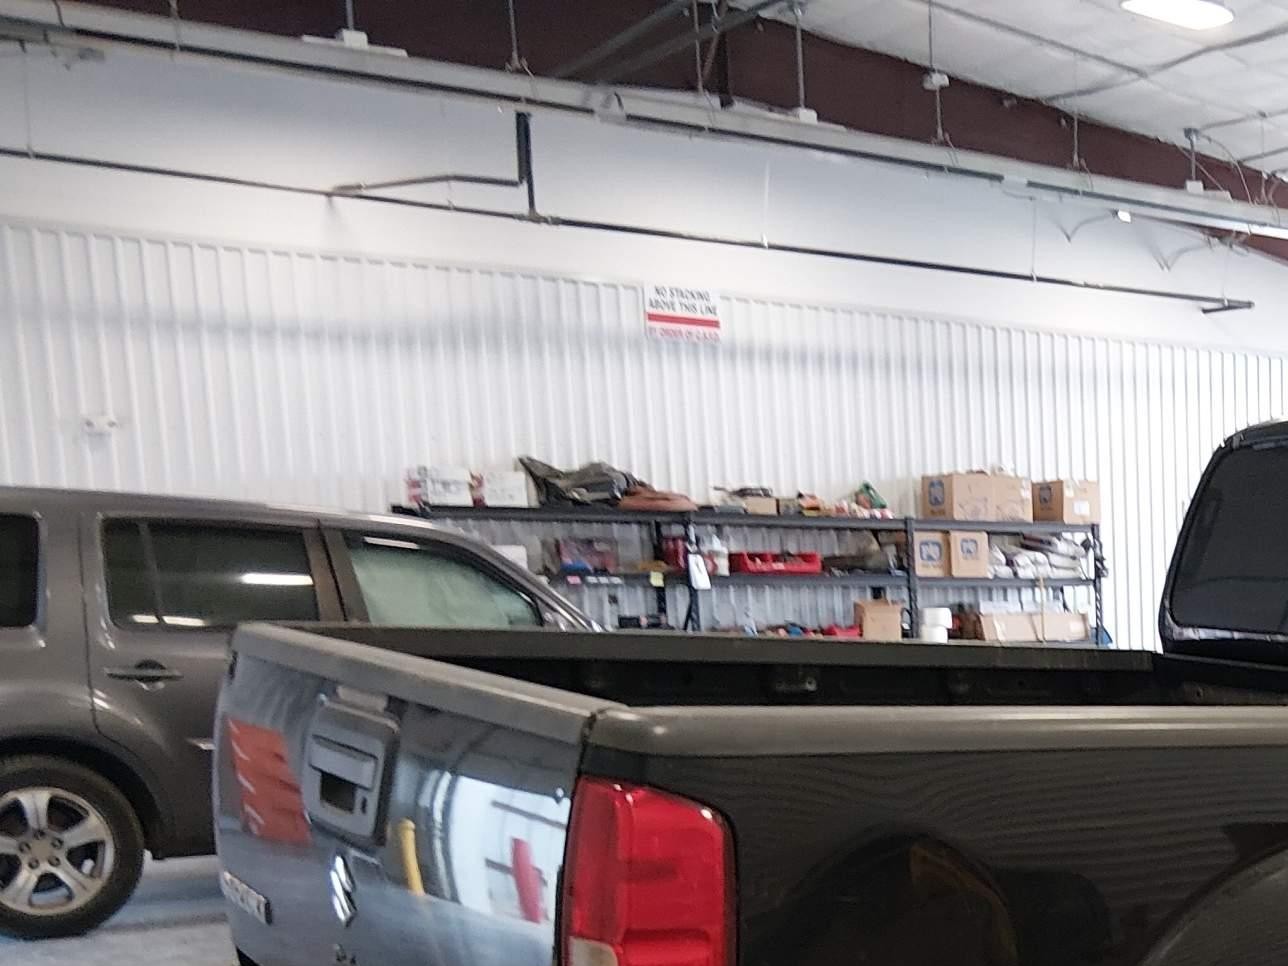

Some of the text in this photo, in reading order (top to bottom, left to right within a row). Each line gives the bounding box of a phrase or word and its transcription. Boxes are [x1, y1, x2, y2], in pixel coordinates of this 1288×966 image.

[654, 285, 711, 302] NO STACKING
[649, 299, 718, 316] ABOVE THIS LINE
